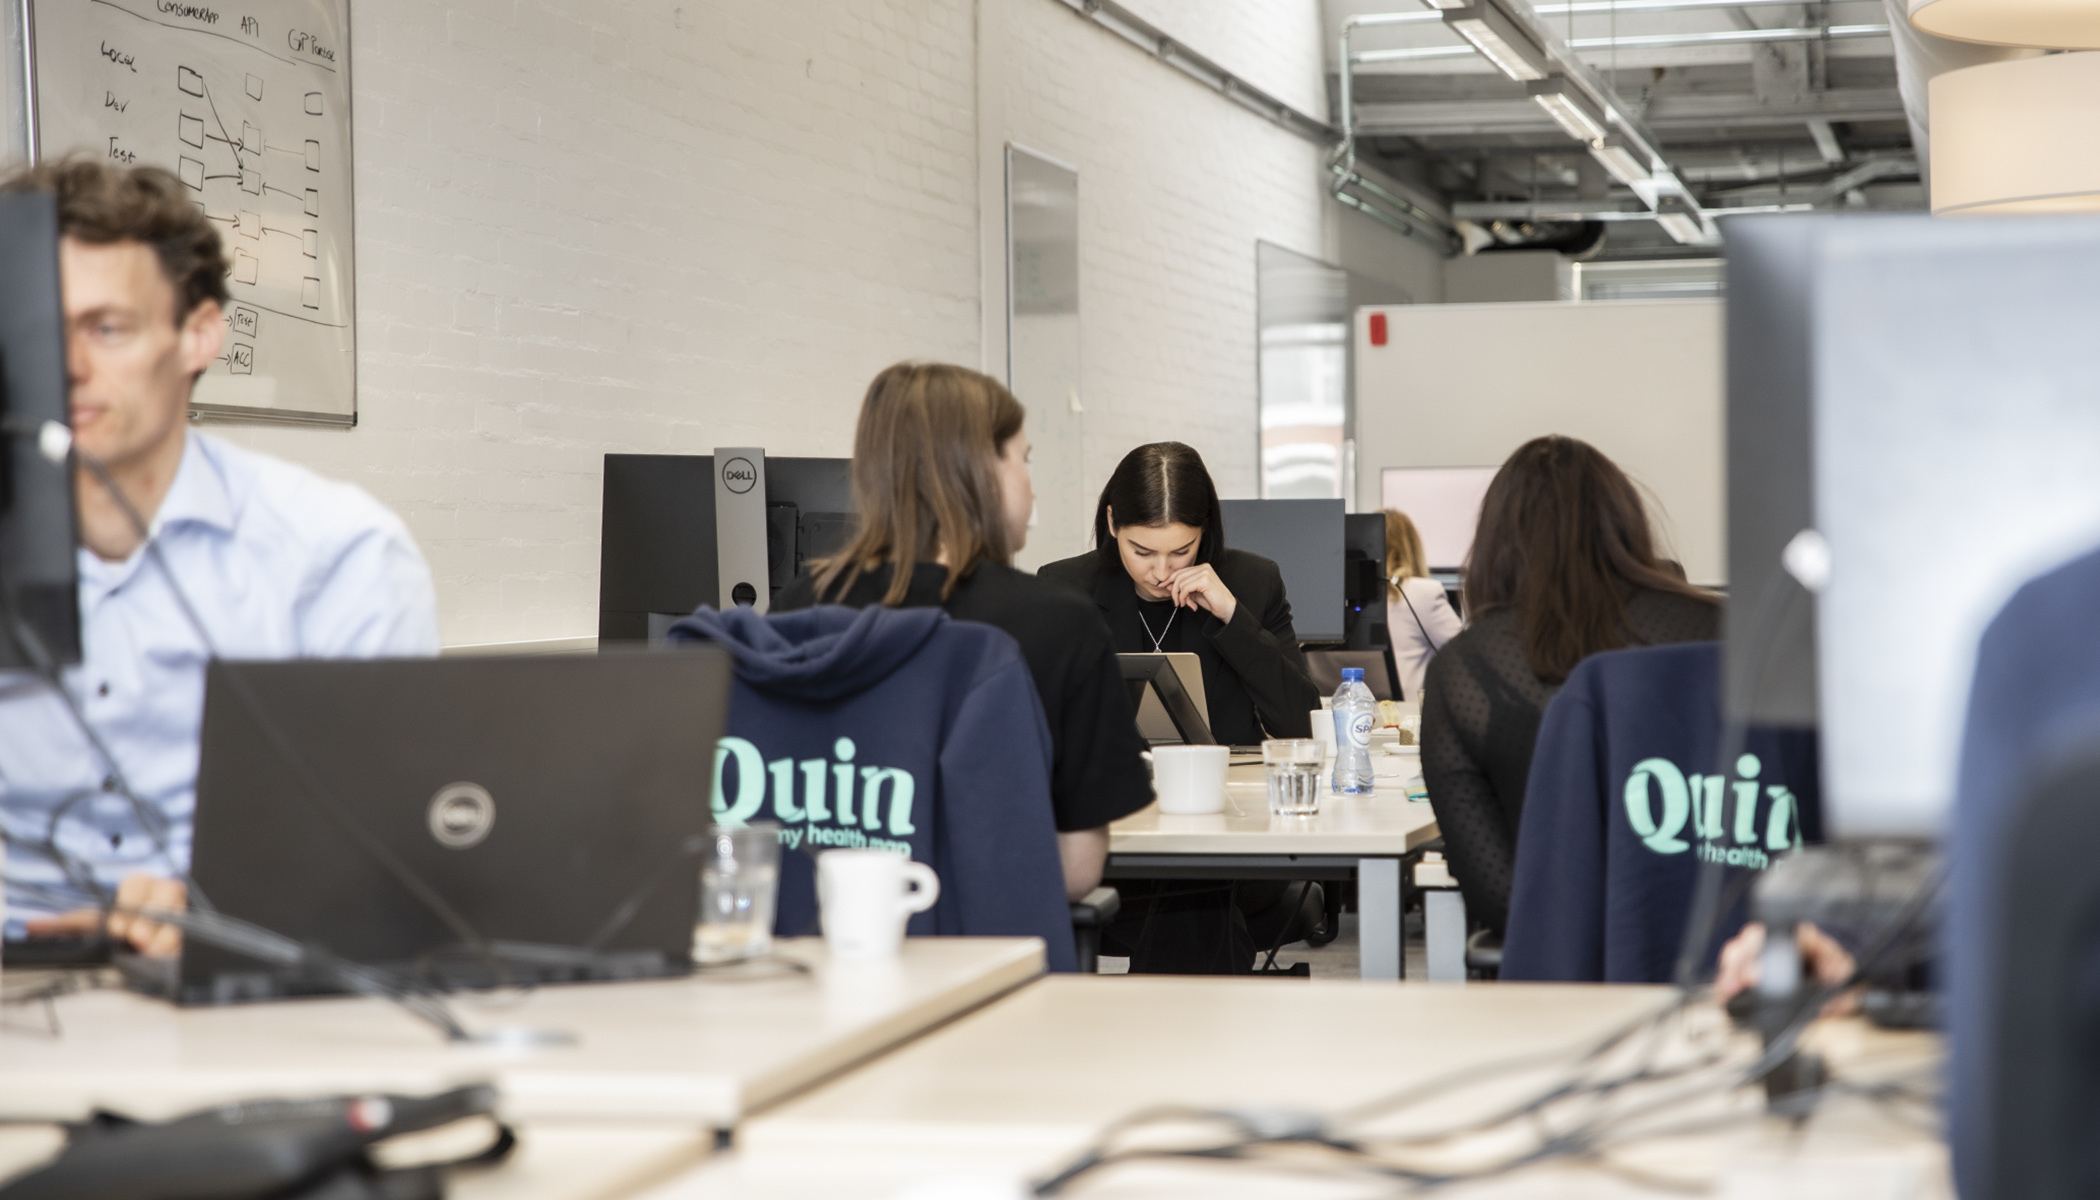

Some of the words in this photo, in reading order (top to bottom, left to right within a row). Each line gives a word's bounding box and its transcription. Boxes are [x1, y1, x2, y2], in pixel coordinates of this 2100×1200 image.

[240, 16, 259, 38] API
[101, 41, 137, 73] Local
[105, 91, 129, 113] Dev
[109, 137, 136, 163] Test
[237, 313, 253, 327] Test
[233, 351, 250, 367] ACC
[726, 470, 753, 480] DELL
[711, 736, 916, 836] Quin
[807, 823, 867, 848] health
